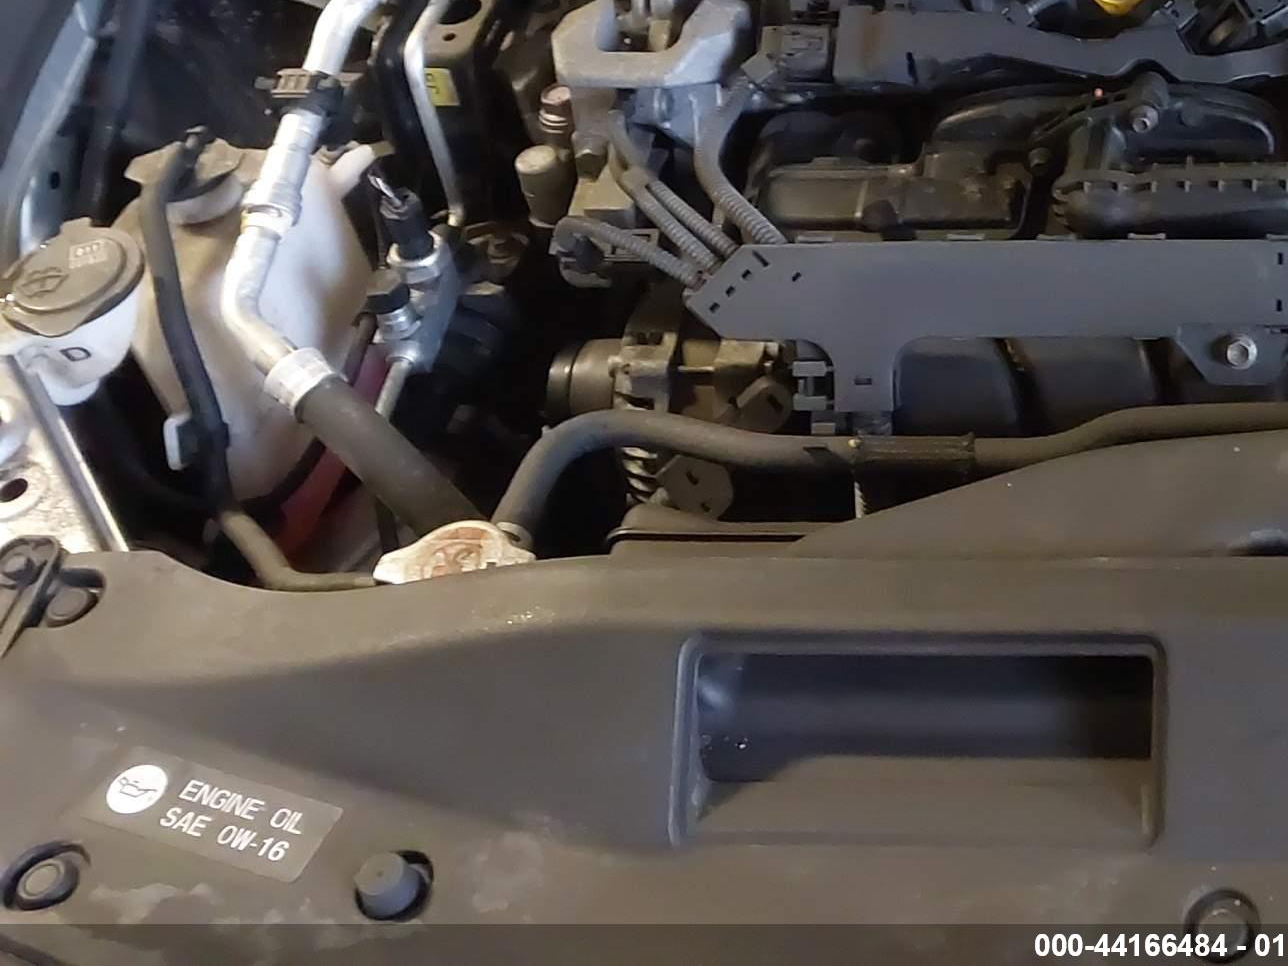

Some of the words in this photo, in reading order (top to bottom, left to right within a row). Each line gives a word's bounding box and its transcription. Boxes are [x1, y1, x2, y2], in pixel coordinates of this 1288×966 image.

[159, 807, 213, 837] SAE
[217, 825, 290, 862] 0W-16
[178, 779, 265, 820] ENGINE
[269, 808, 304, 835] OIL
